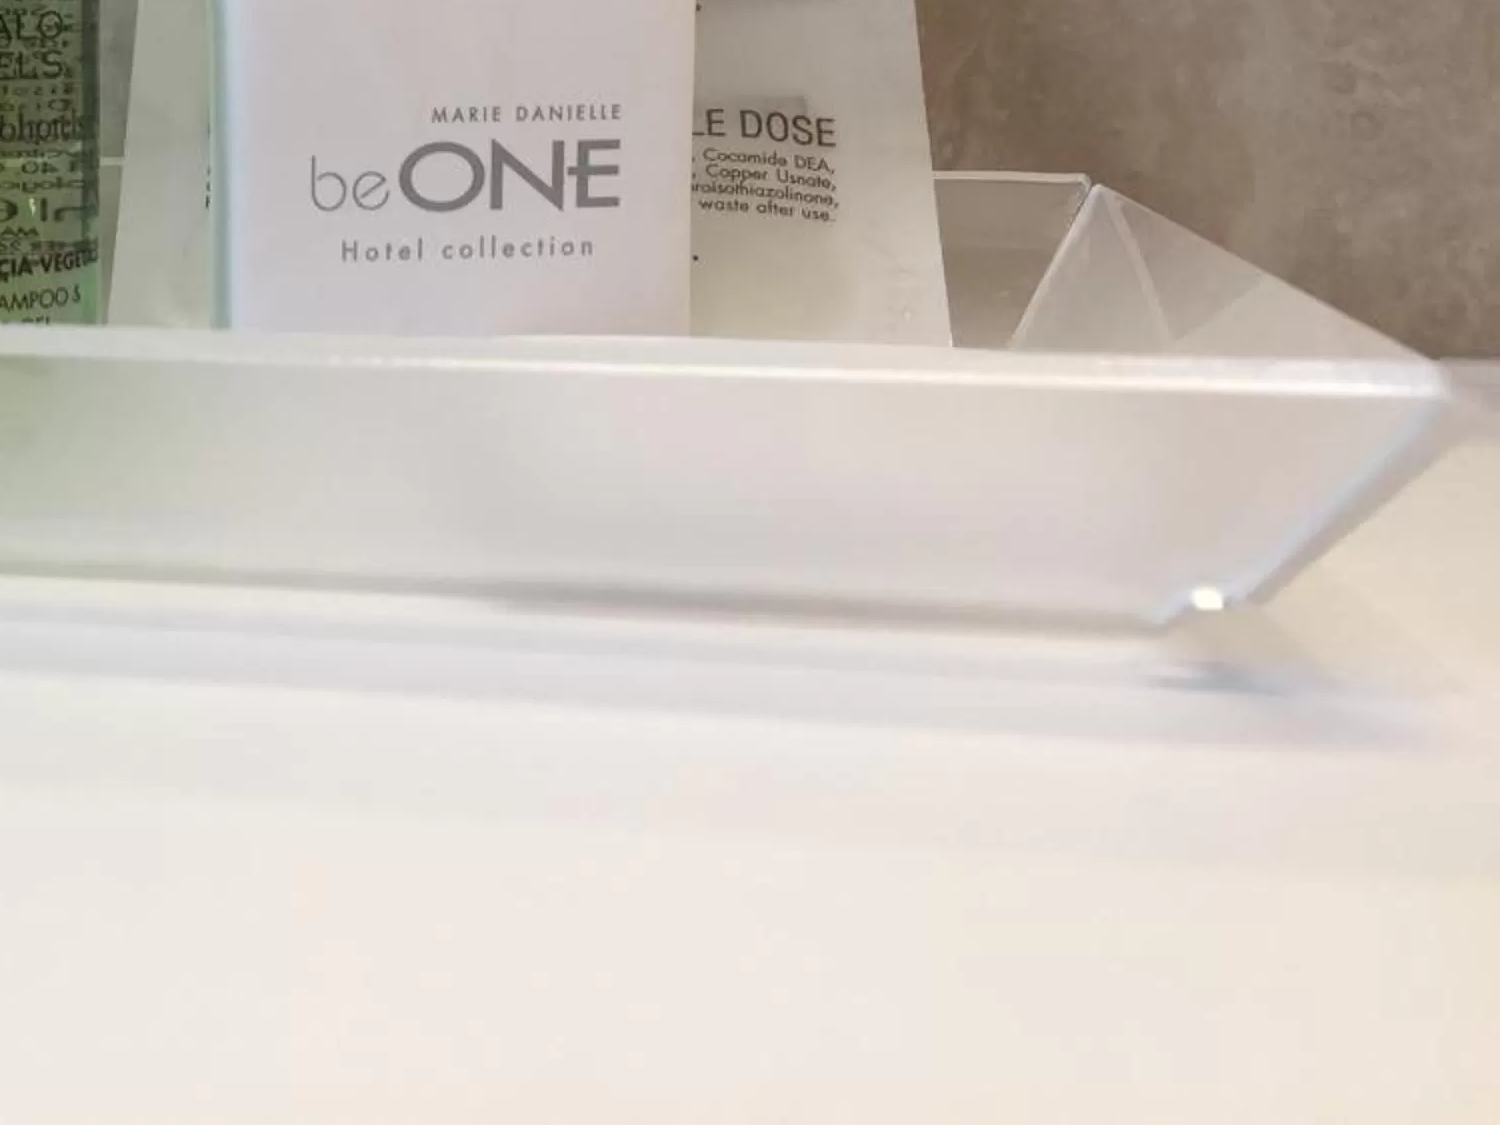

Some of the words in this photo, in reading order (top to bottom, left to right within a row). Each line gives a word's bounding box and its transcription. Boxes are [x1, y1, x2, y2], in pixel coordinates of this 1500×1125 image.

[431, 106, 502, 123] MARIE
[515, 103, 621, 122] DANIELLE
[740, 109, 837, 147] DOSE
[702, 147, 788, 167] Cocamide
[794, 154, 835, 175] DEA,
[705, 163, 769, 182] Copper
[691, 181, 839, 209] roisothiazolinone,
[698, 198, 750, 213] waste
[756, 200, 795, 217] after
[341, 236, 424, 263] Hotel
[441, 234, 595, 260] collection
